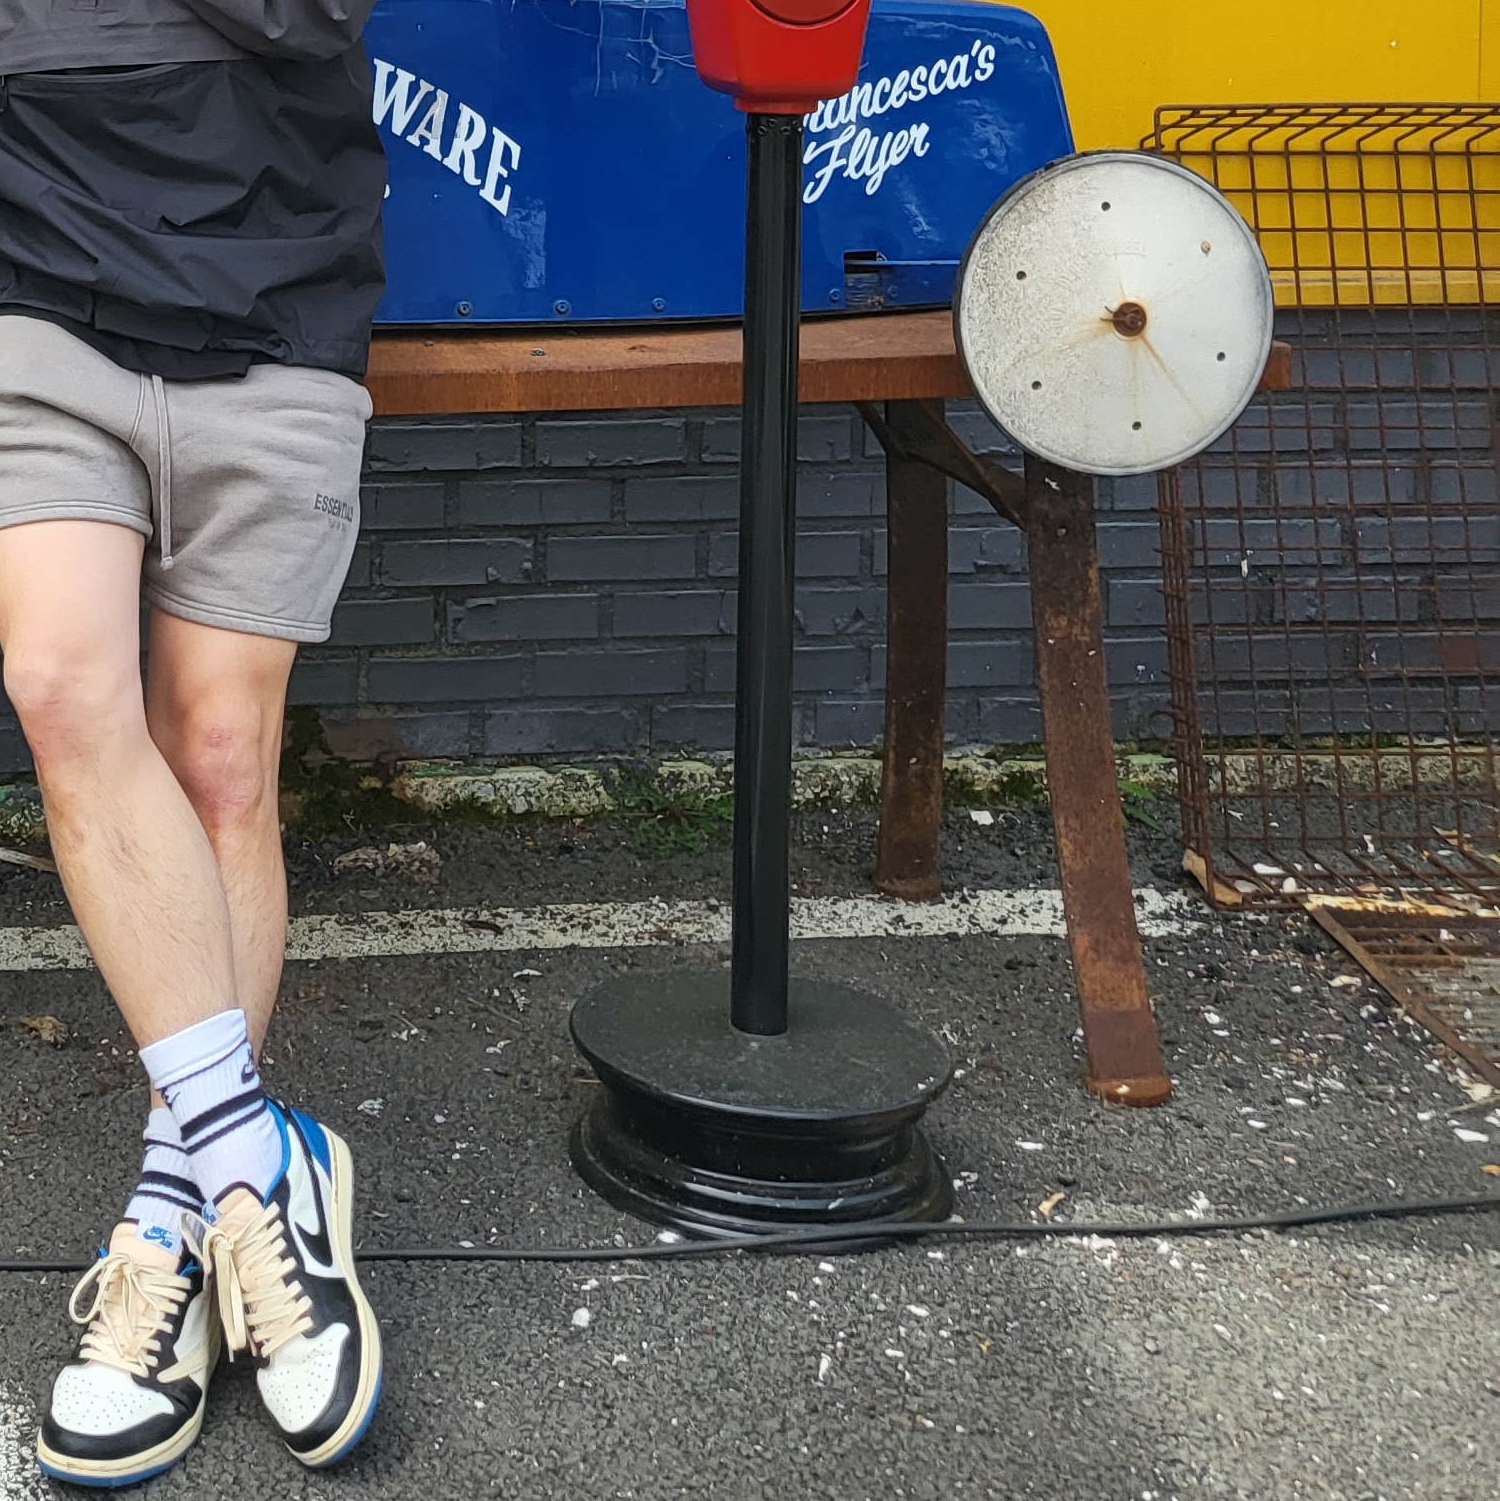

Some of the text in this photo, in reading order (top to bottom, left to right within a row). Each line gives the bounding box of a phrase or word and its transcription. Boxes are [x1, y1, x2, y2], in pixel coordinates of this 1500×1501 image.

[802, 40, 996, 134] rancesca's
[372, 57, 522, 217] WARE
[802, 123, 931, 204] Flyer
